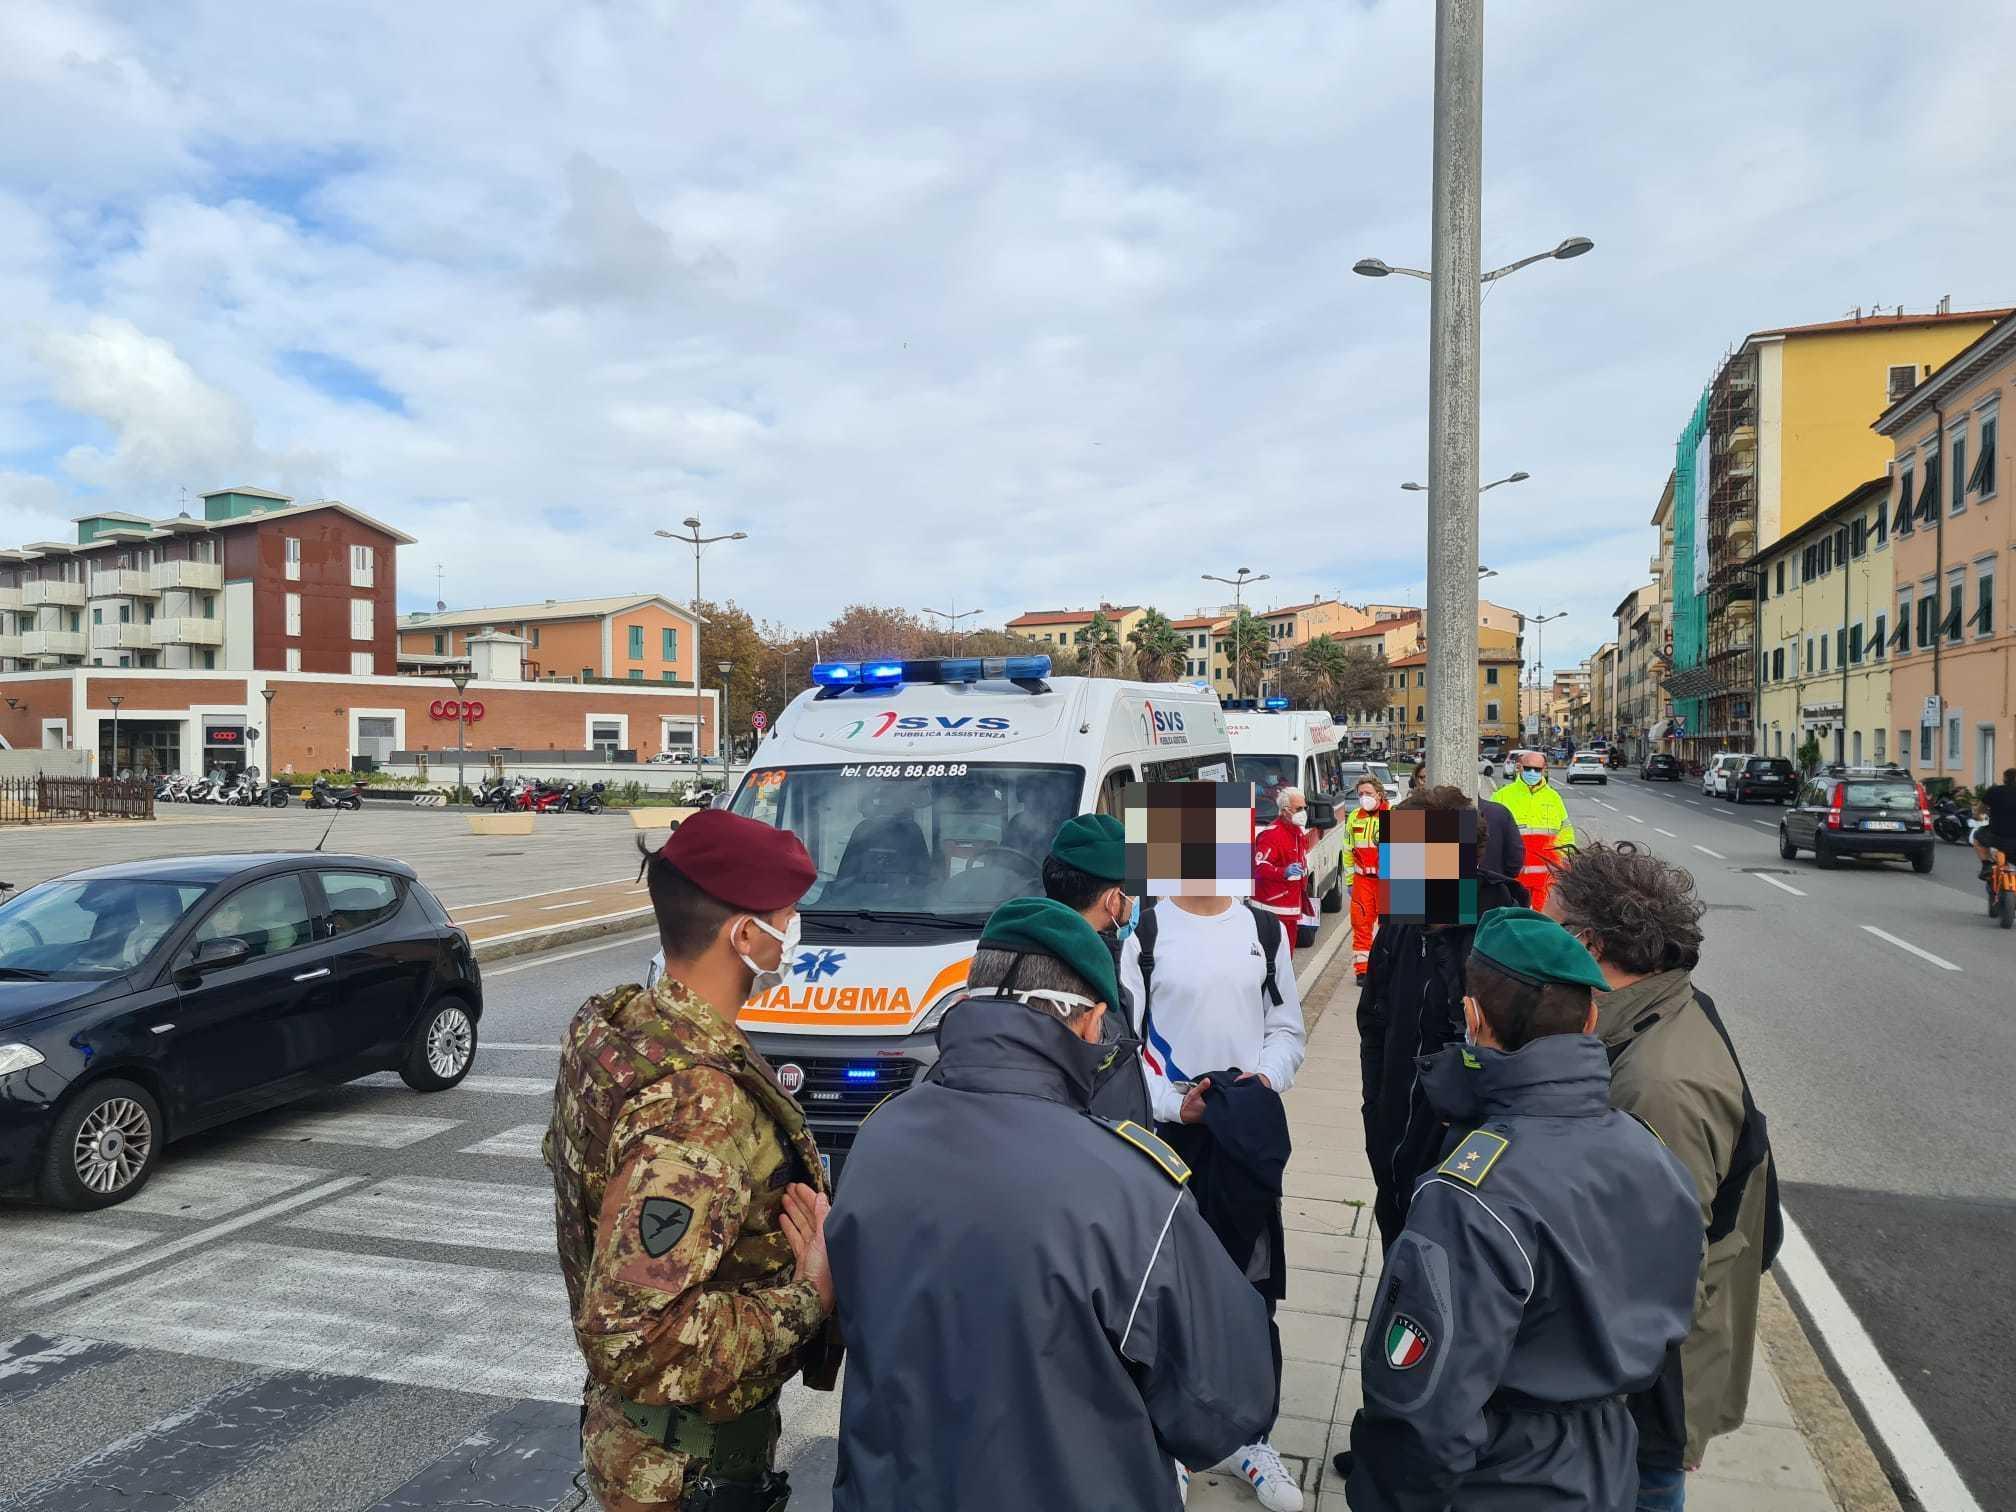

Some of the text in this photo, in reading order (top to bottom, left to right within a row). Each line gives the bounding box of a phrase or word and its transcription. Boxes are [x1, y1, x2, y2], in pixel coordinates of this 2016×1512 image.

[430, 700, 485, 725] coop
[896, 716, 1010, 730] SVS
[1154, 710, 1185, 732] SVS
[944, 731, 1006, 739] ASSISTENZA
[840, 763, 967, 777] tel. 0586 88.88.88
[783, 1072, 799, 1087] FIAT
[1399, 1318, 1426, 1343] ITALIA
